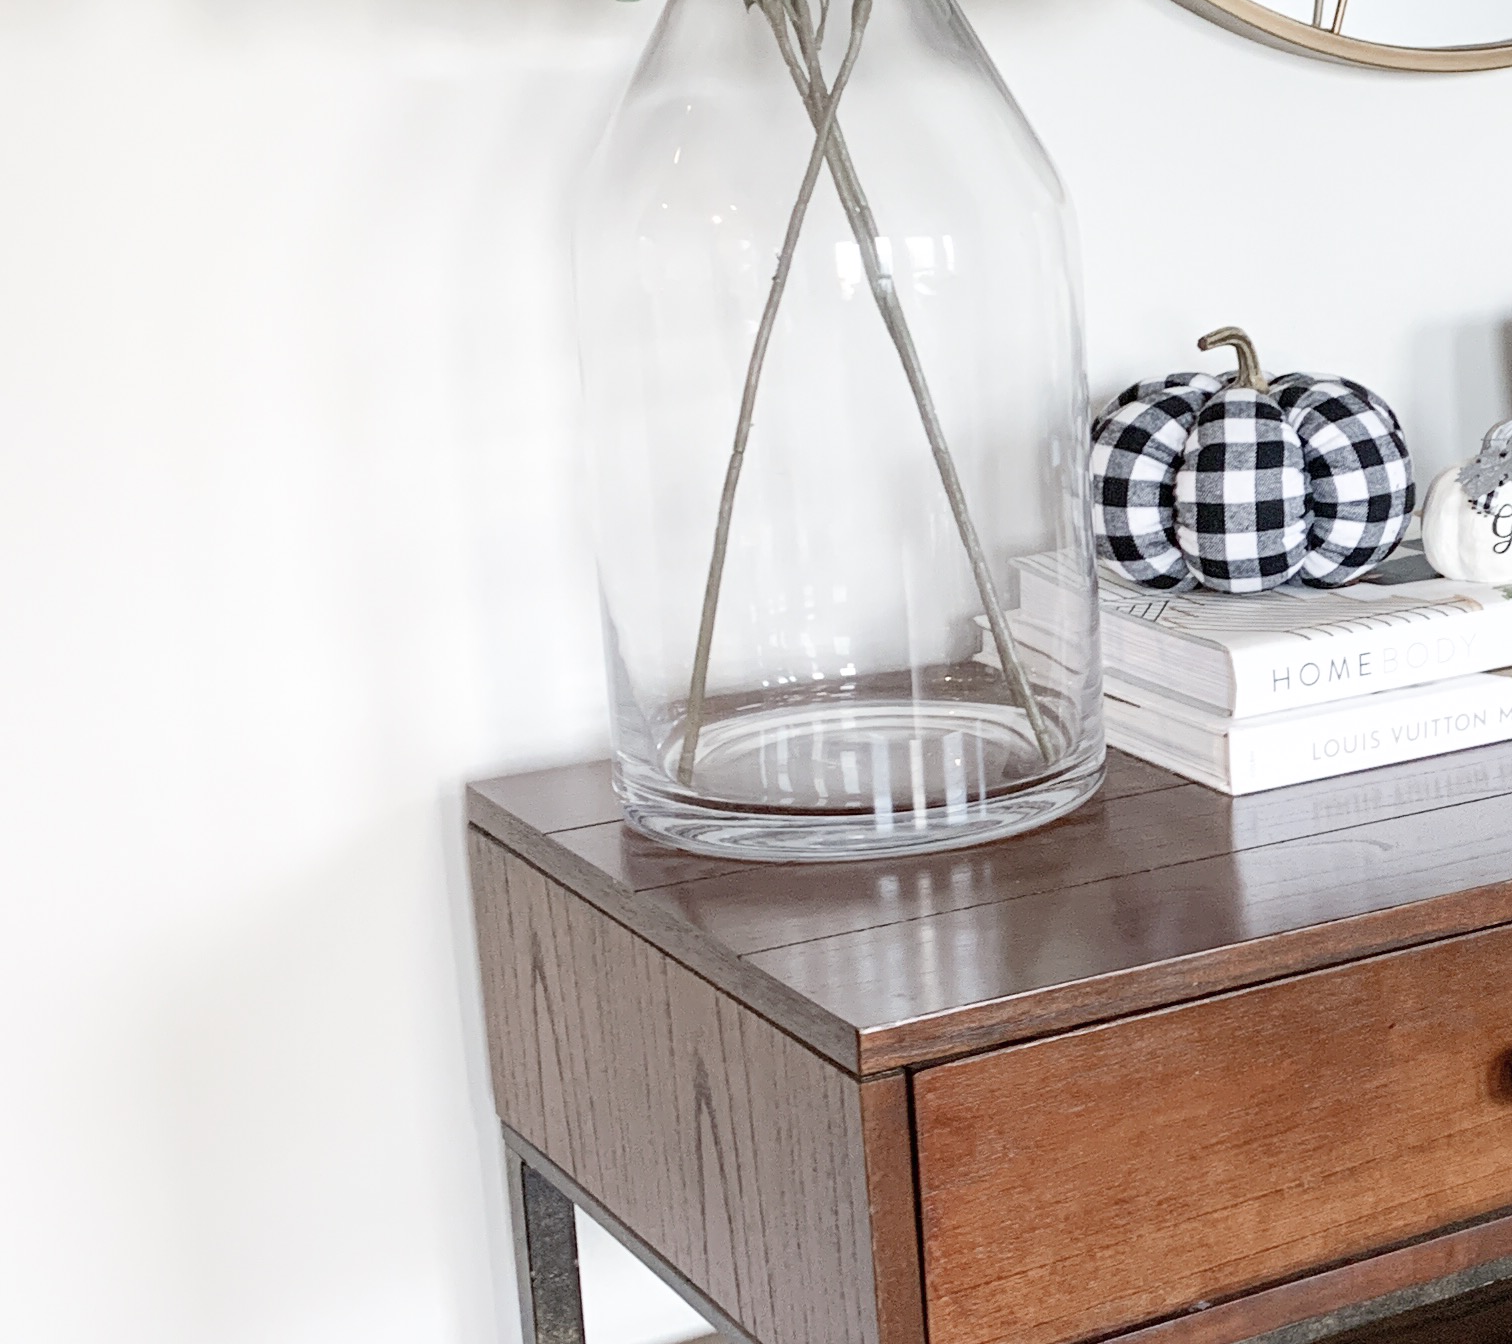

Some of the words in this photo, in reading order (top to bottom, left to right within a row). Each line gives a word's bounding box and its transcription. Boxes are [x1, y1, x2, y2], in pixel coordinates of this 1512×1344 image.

[1272, 633, 1476, 692] HOMEBODY
[1312, 730, 1381, 761] LOUIS
[1391, 709, 1487, 744] VUITTON
